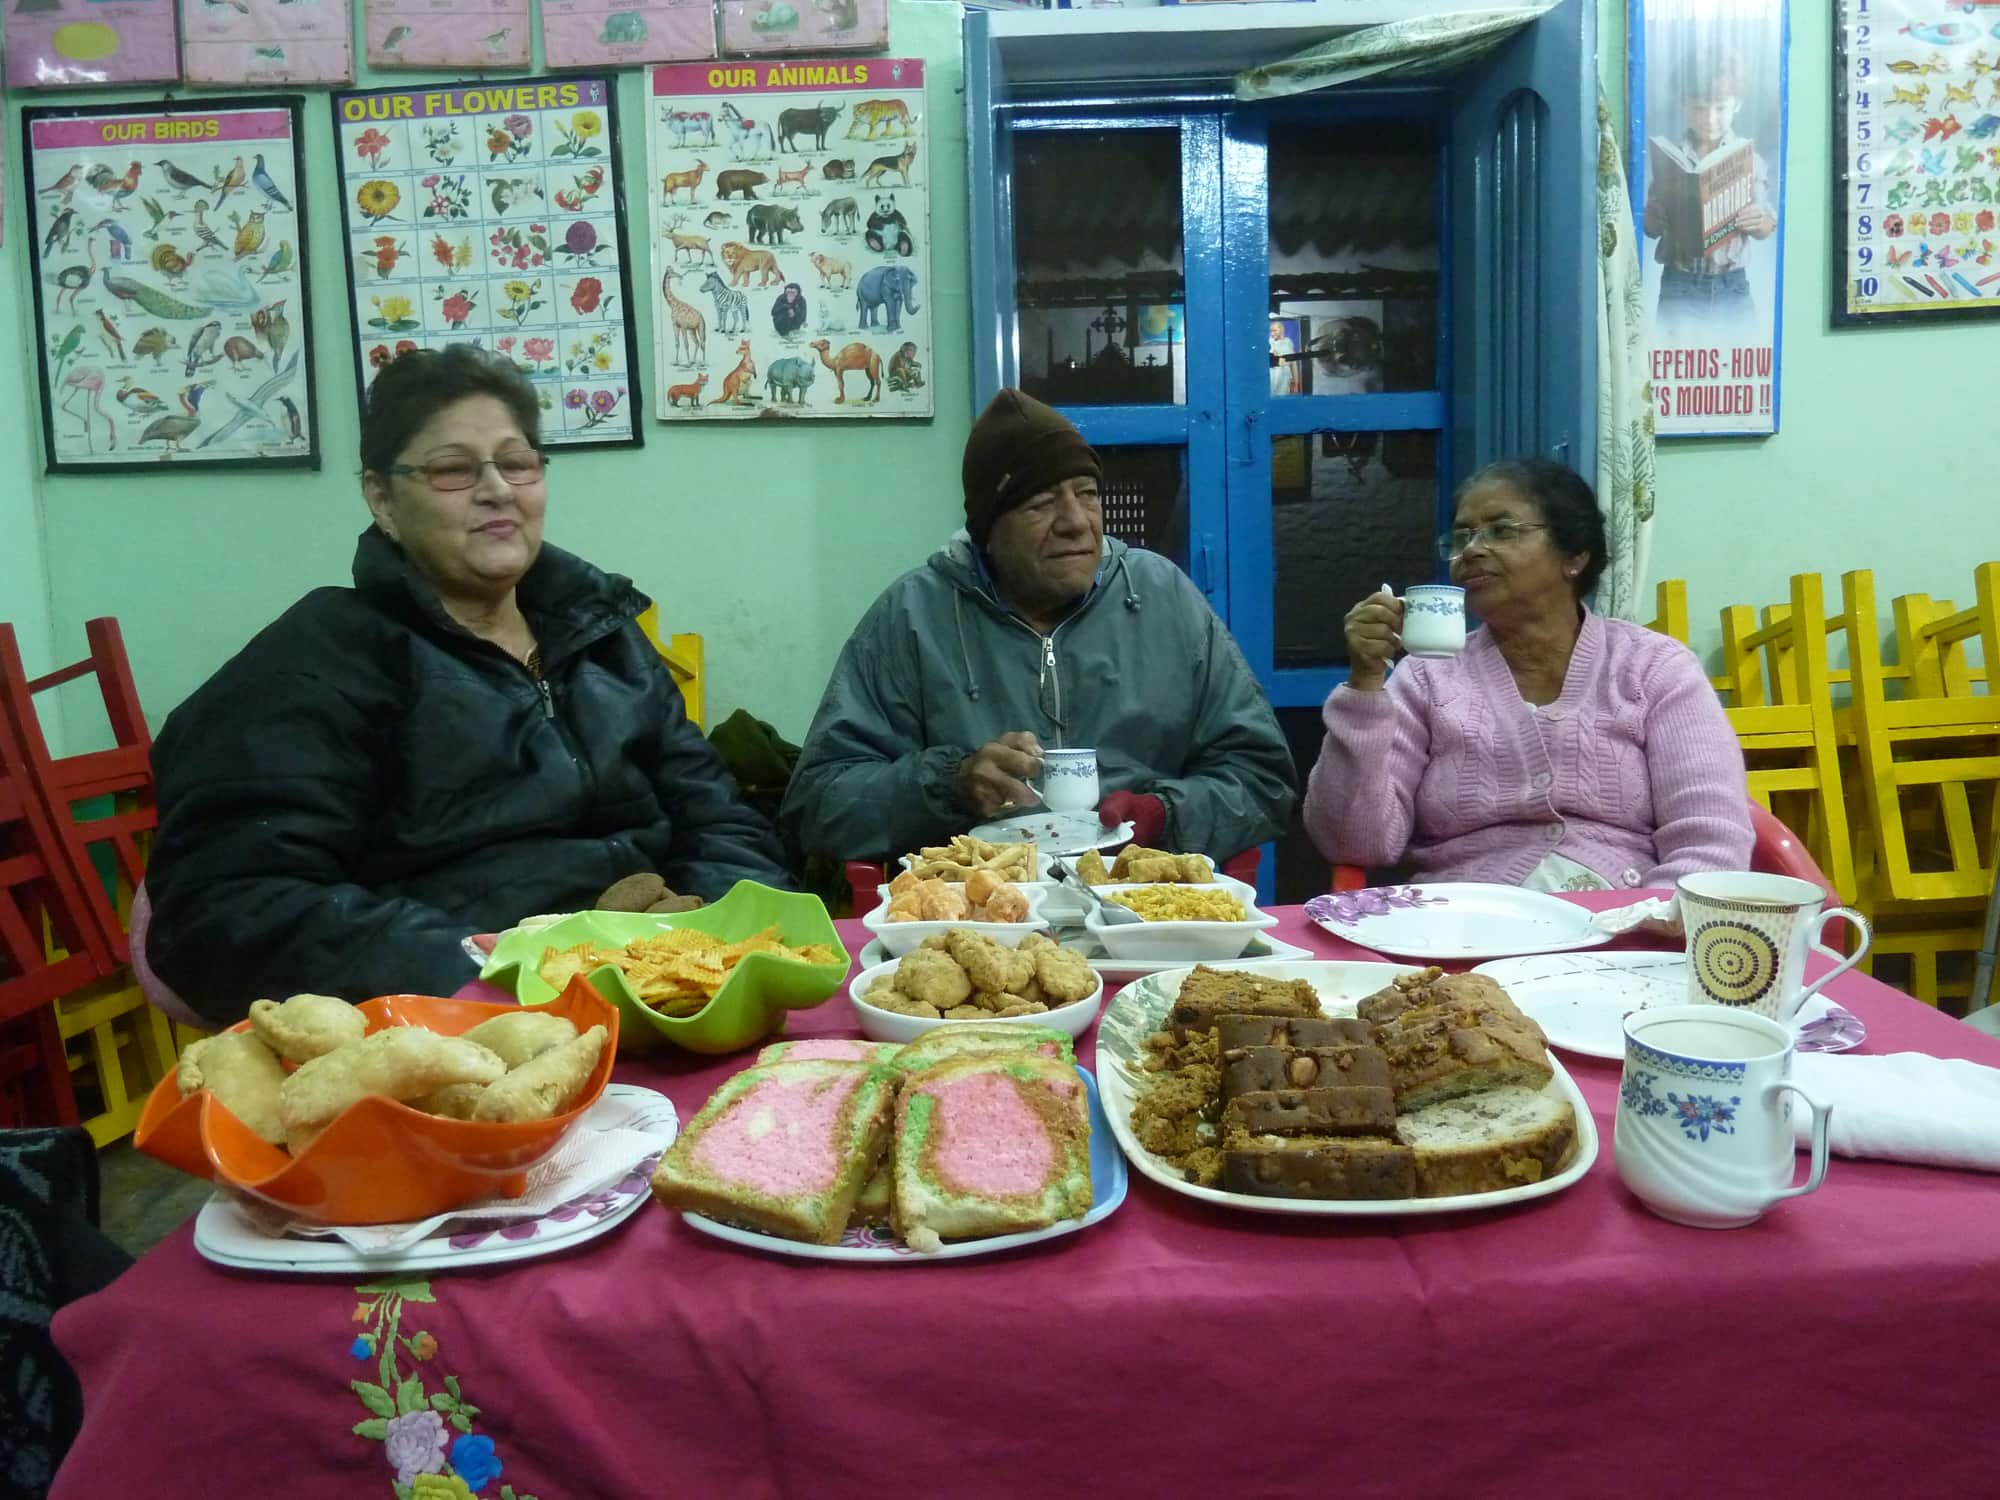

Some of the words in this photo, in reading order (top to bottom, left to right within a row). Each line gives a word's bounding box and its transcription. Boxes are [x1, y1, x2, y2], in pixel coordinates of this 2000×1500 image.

[1856, 25, 1870, 46] 2
[708, 68, 756, 88] OUR
[767, 64, 868, 87] ANIMALS
[1856, 57, 1871, 78] 3
[343, 96, 415, 121] OUR
[424, 83, 580, 116] FLOWERS
[1856, 90, 1871, 109] 4
[101, 123, 146, 141] OUR
[154, 119, 220, 139] BIRDS
[1857, 120, 1871, 141] 5
[1856, 152, 1871, 172] 6
[1857, 183, 1872, 204] 7
[1858, 215, 1872, 236] 8
[1858, 246, 1873, 266] 9
[1854, 276, 1878, 297] 10
[1676, 384, 1754, 417] MOULDED
